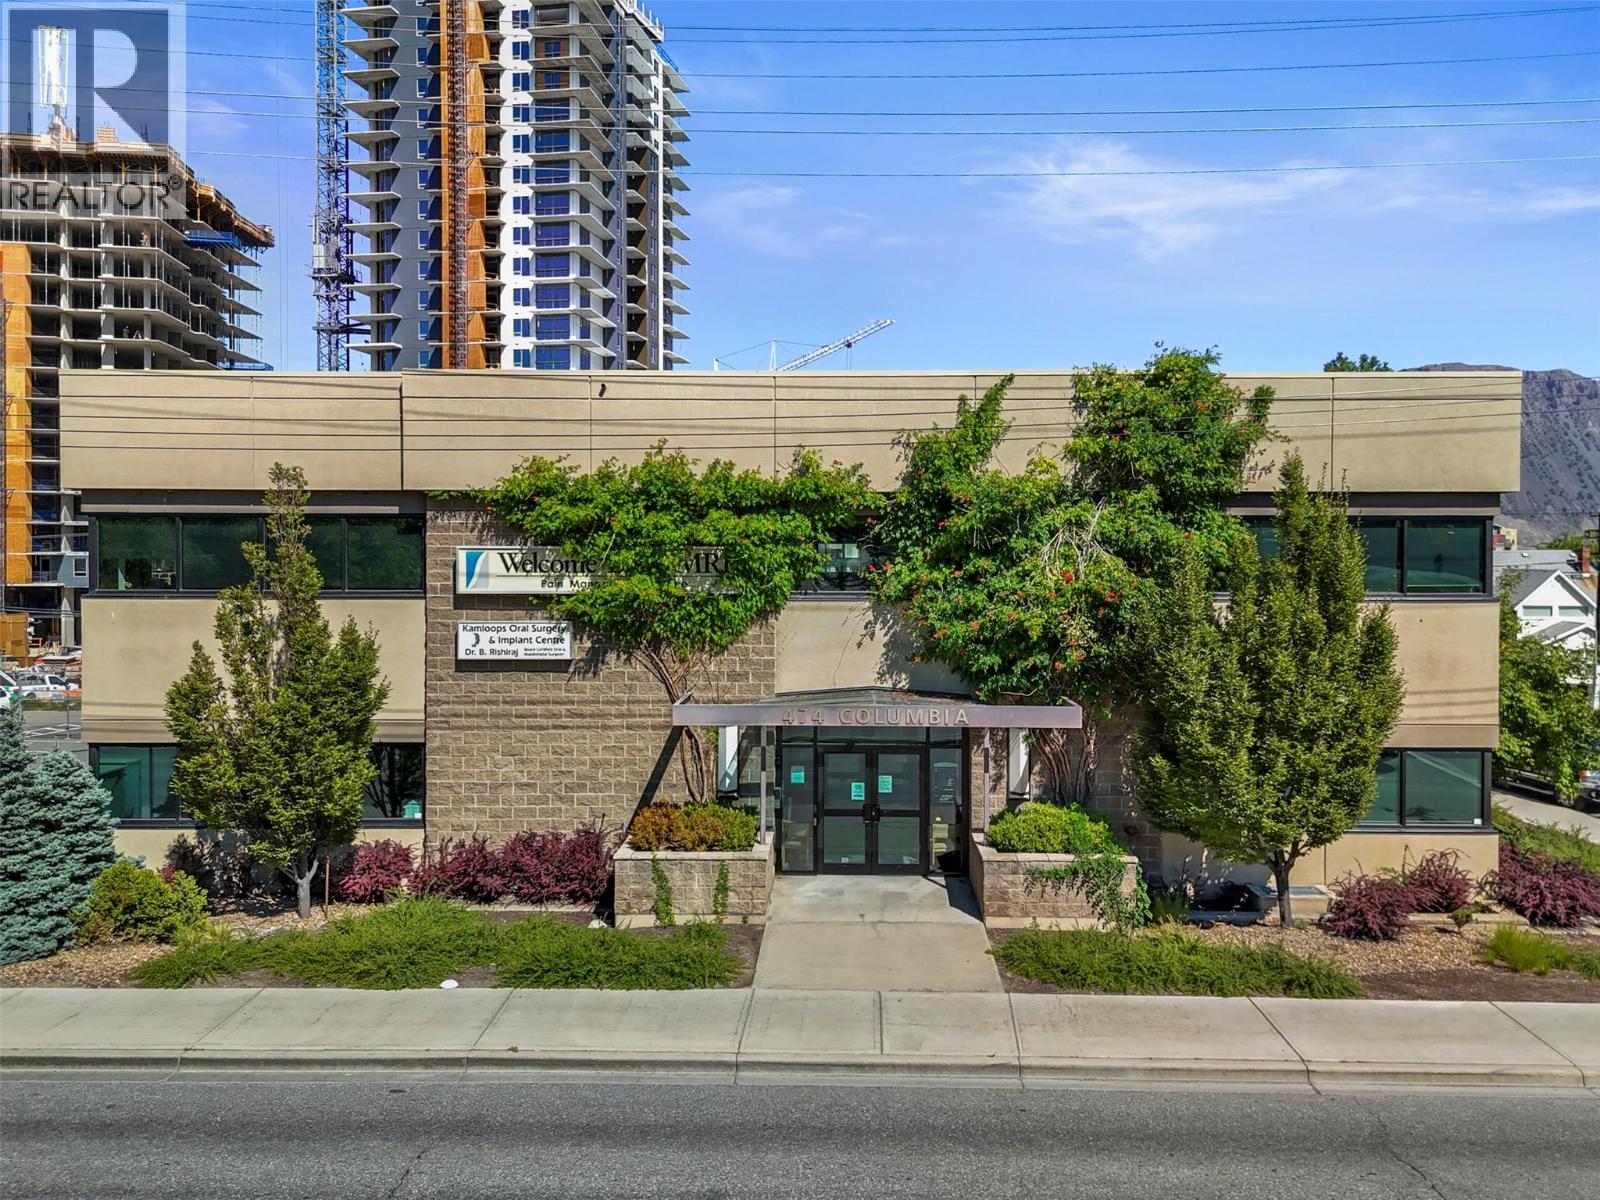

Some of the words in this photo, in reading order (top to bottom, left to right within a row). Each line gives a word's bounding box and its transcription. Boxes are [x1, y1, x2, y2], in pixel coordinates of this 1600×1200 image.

[497, 552, 597, 573] Welcome
[541, 579, 563, 589] Pain
[462, 624, 507, 636] Kamloops
[509, 624, 528, 633] Oral
[532, 624, 567, 635] Surgery
[488, 636, 496, 644] &
[498, 636, 533, 645] Implant
[535, 636, 565, 644] Centre
[465, 648, 477, 656] Dr.
[479, 648, 487, 656] B.
[489, 648, 519, 657] Rishiraj
[782, 708, 824, 725] 474
[839, 708, 969, 725] COLUMBIA
